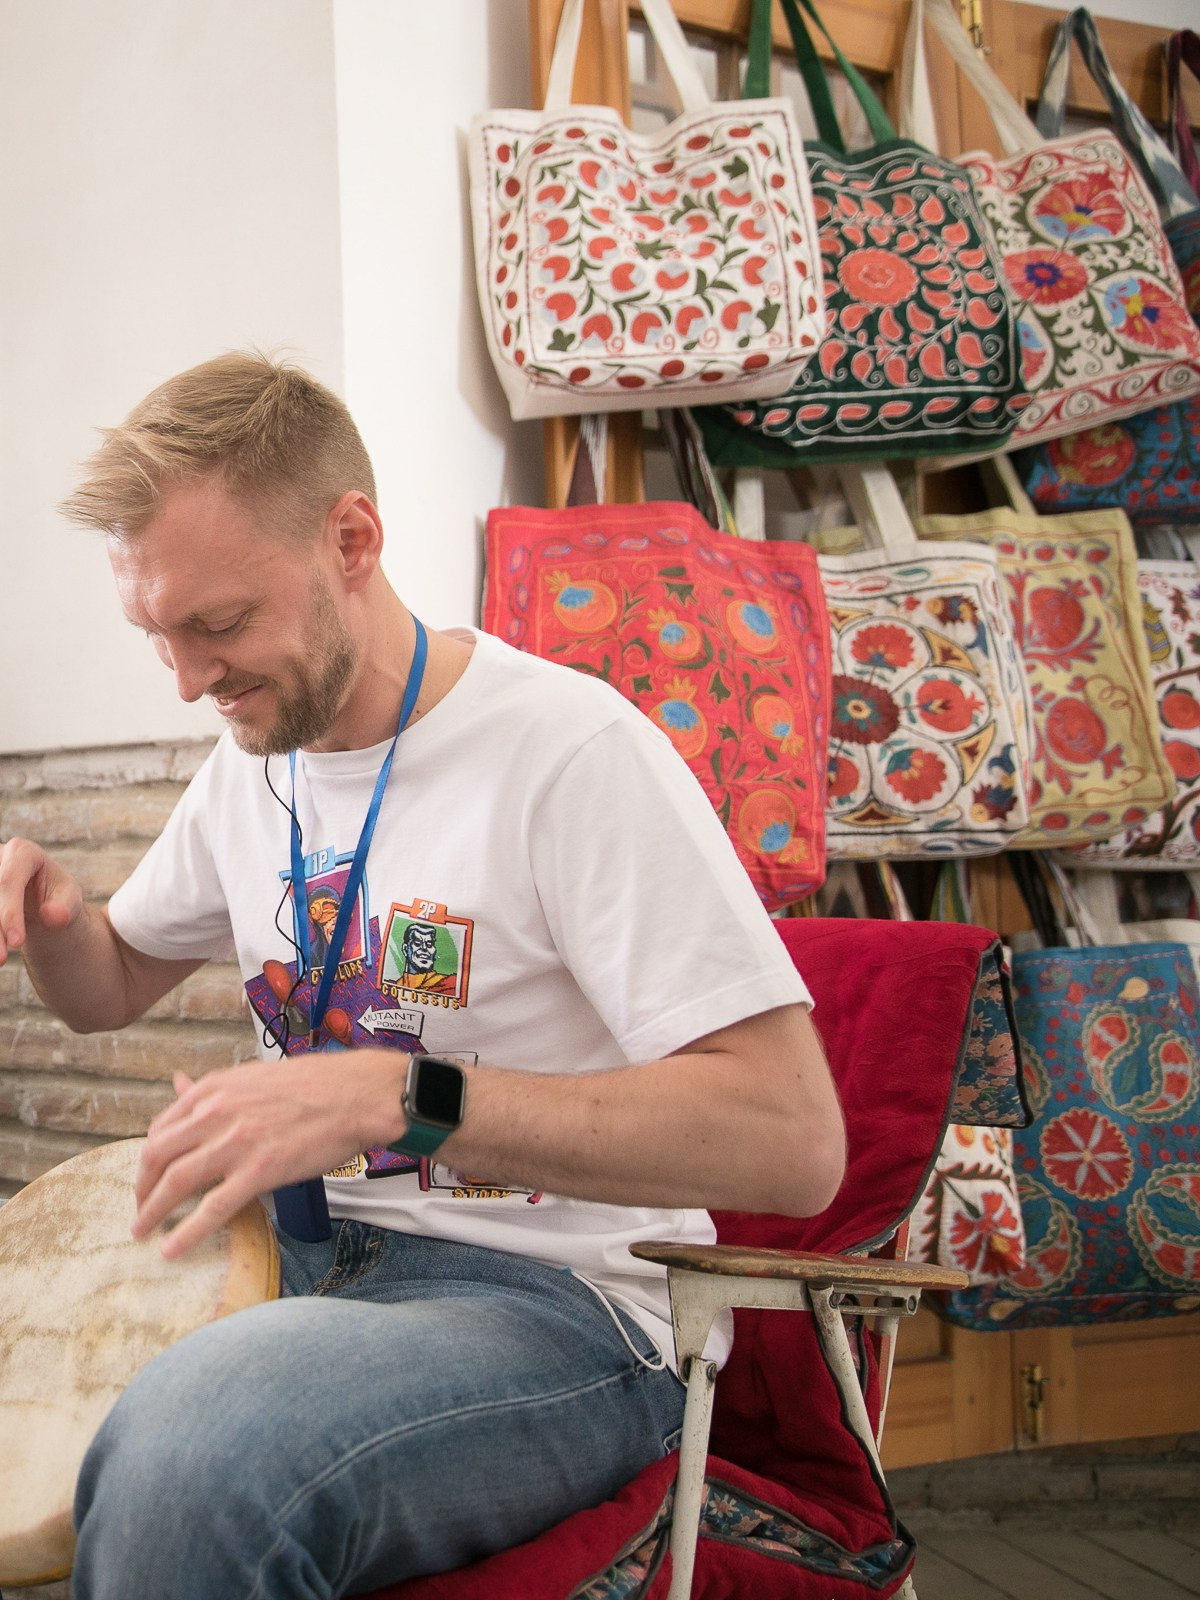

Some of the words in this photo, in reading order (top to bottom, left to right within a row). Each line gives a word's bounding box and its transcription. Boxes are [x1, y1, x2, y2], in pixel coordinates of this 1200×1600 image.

[312, 849, 329, 873] 1P
[416, 902, 437, 920] 2P
[310, 960, 363, 985] CLOPS
[381, 983, 460, 1010] COLOSSUS
[363, 1011, 416, 1024] MUTANT
[376, 1020, 415, 1031] POWER
